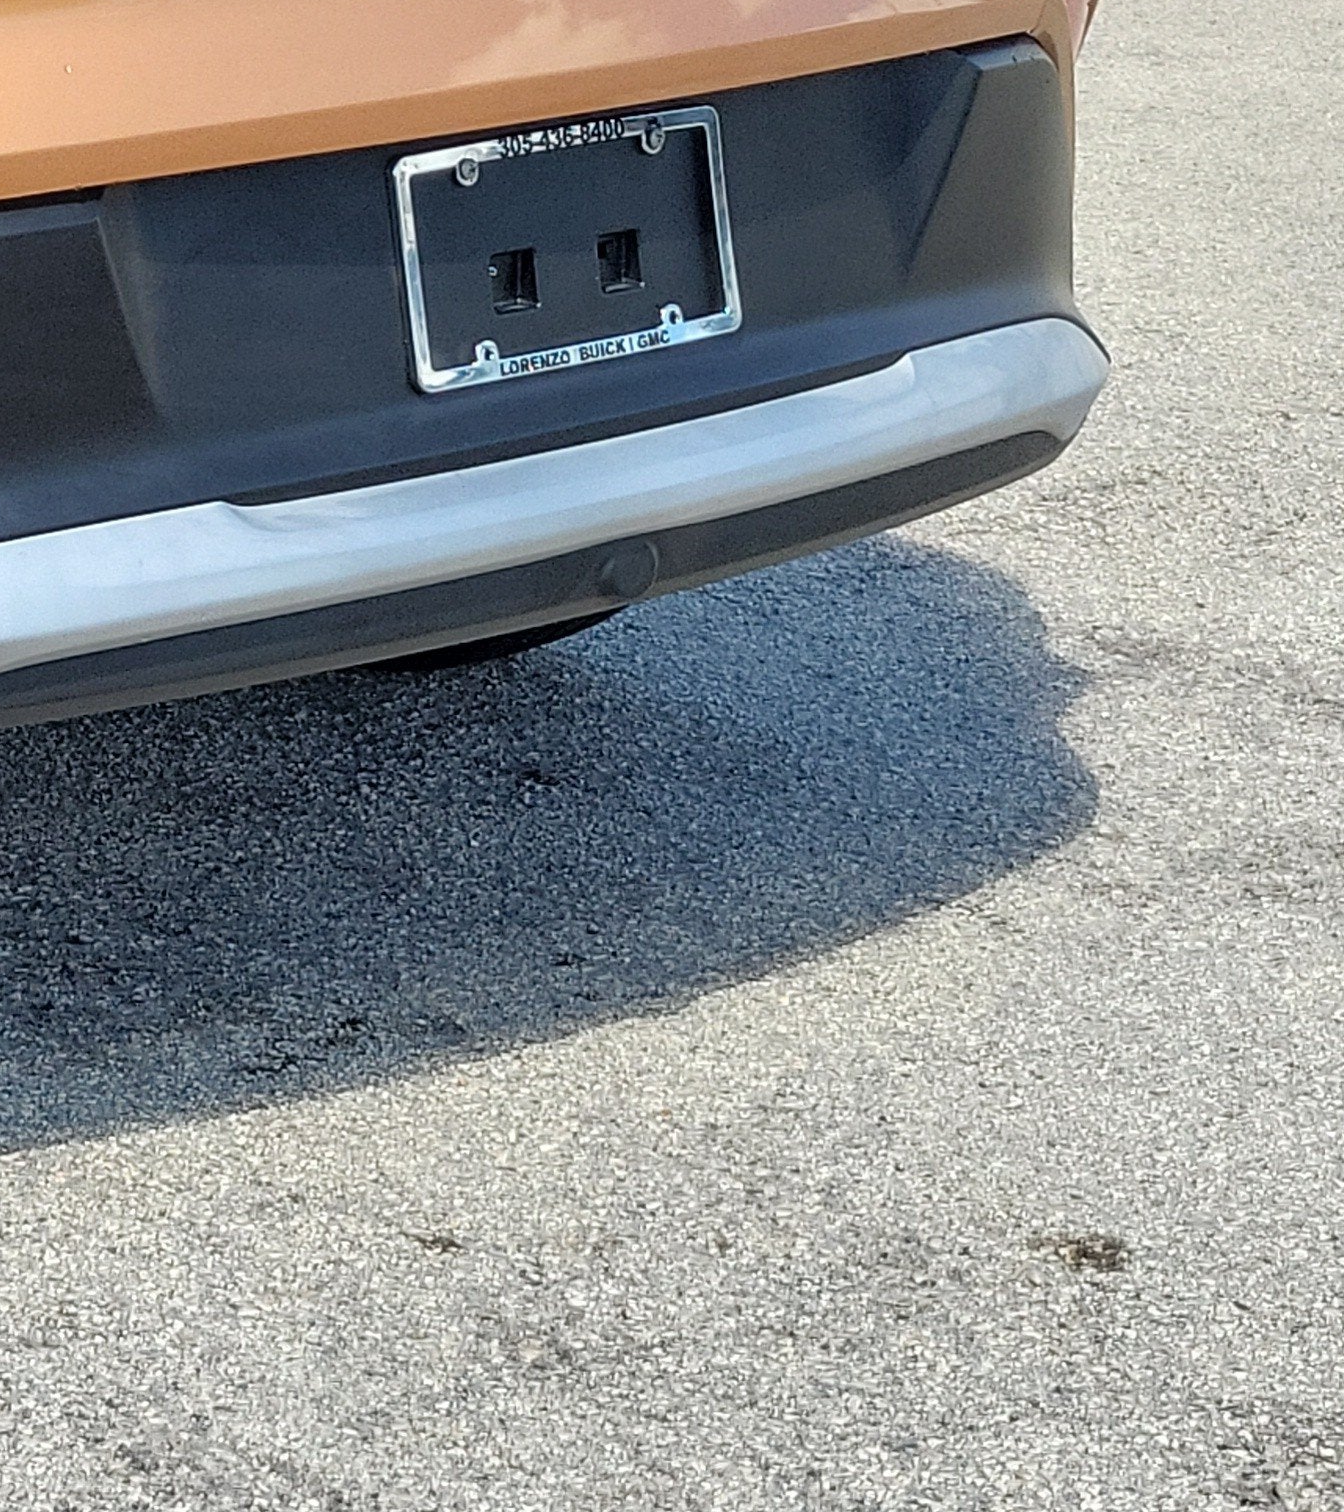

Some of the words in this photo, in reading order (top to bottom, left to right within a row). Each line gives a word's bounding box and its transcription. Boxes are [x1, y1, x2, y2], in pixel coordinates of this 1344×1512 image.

[498, 117, 625, 158] 305-436-8400
[499, 349, 571, 377] LORENZO
[578, 338, 627, 361] BUICK
[636, 330, 671, 349] GMC
